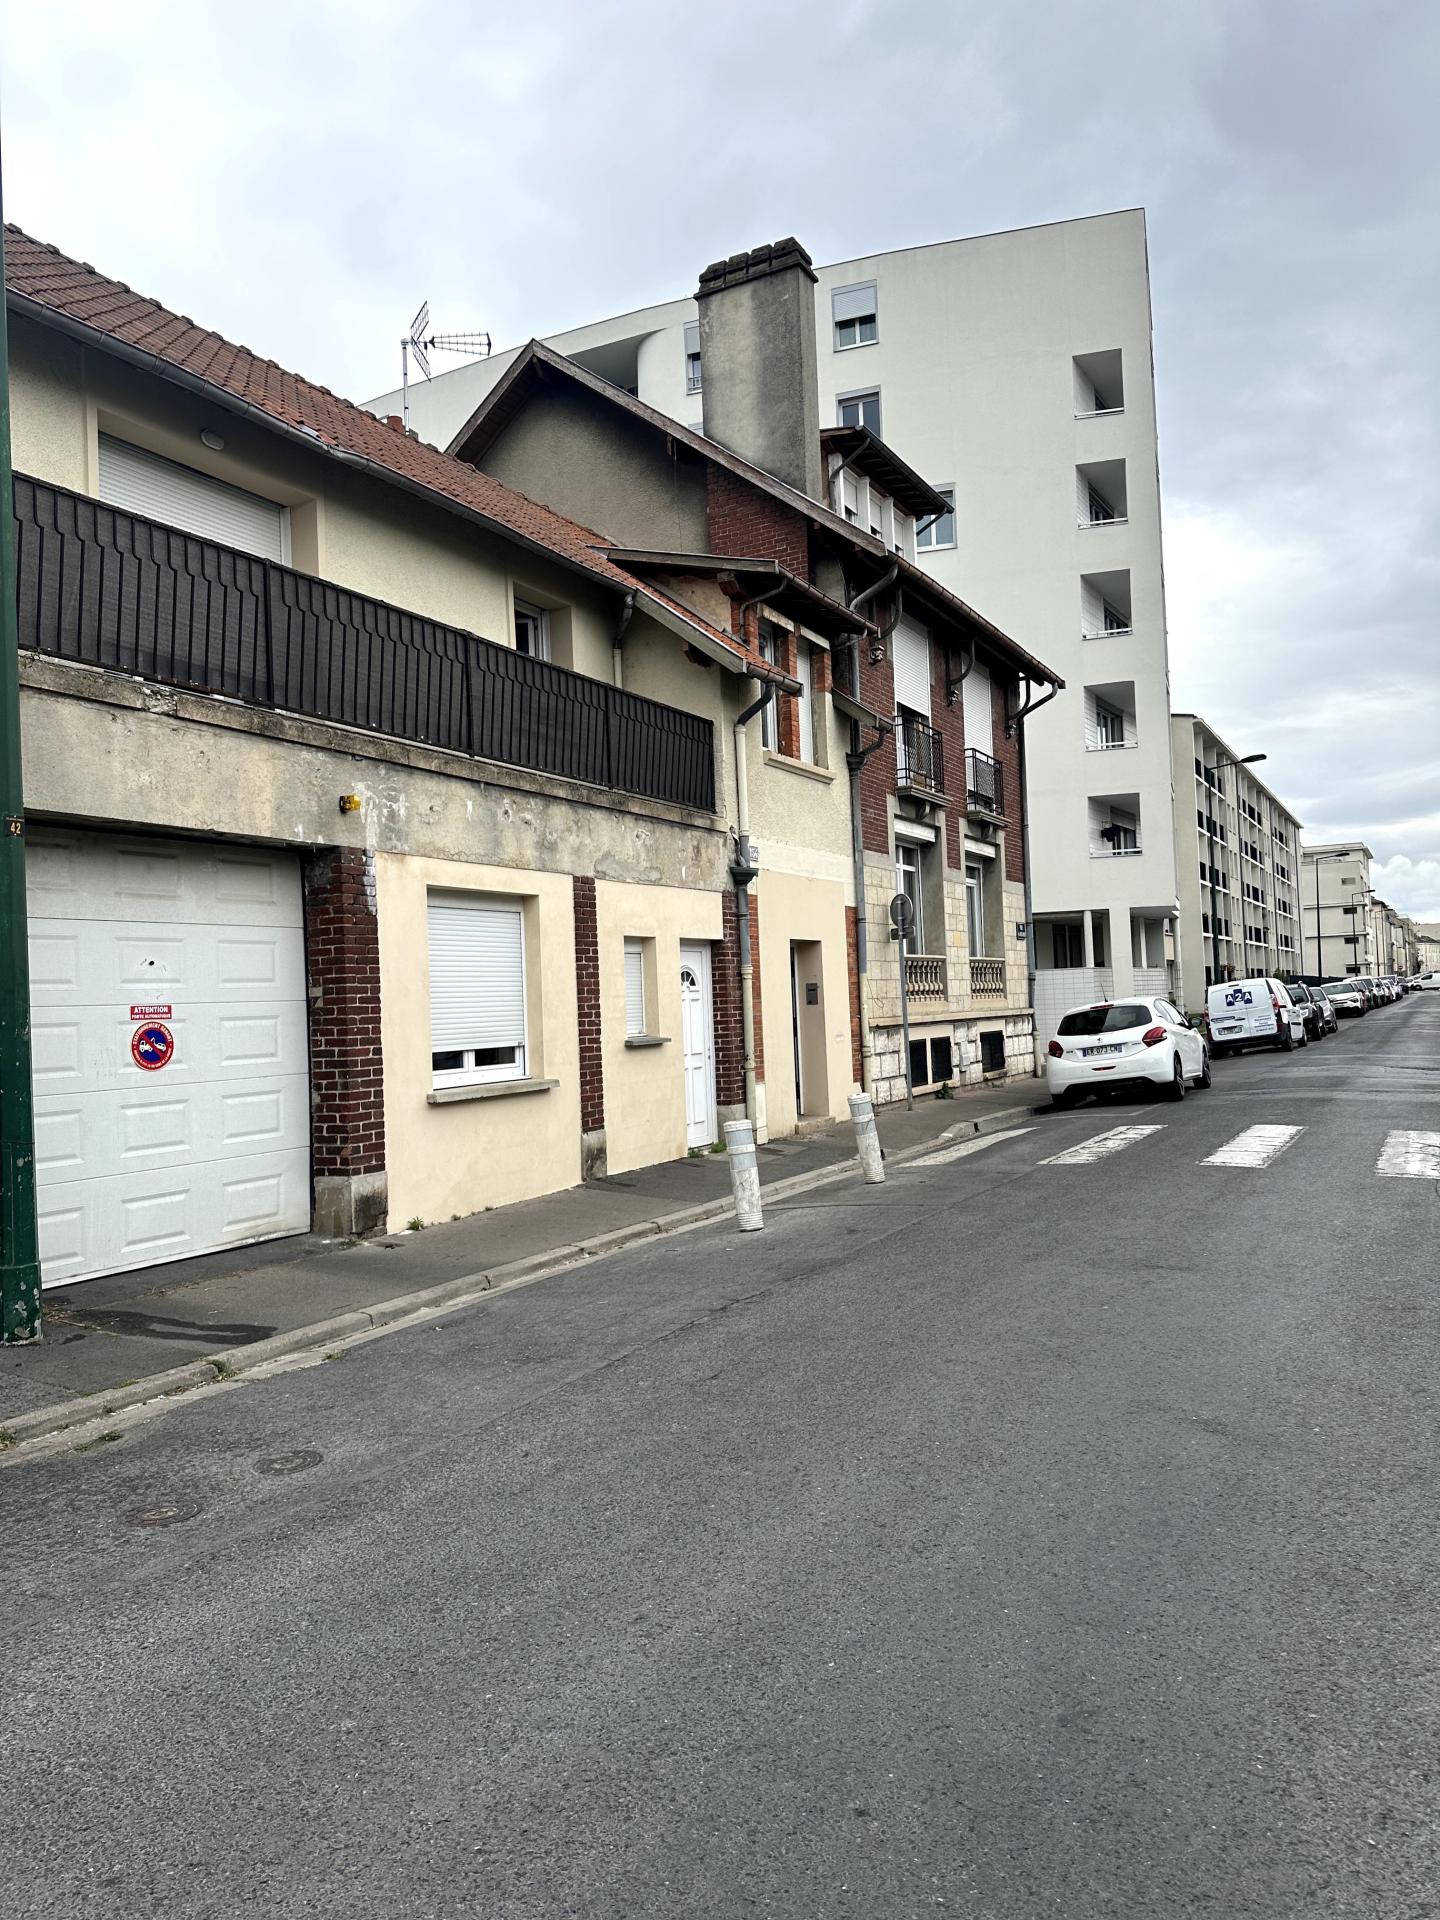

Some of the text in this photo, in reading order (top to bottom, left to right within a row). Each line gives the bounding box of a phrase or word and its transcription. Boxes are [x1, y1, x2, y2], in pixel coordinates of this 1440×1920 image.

[10, 822, 21, 833] 42
[1226, 992, 1252, 1002] A2A
[134, 1006, 168, 1014] ATTENTION
